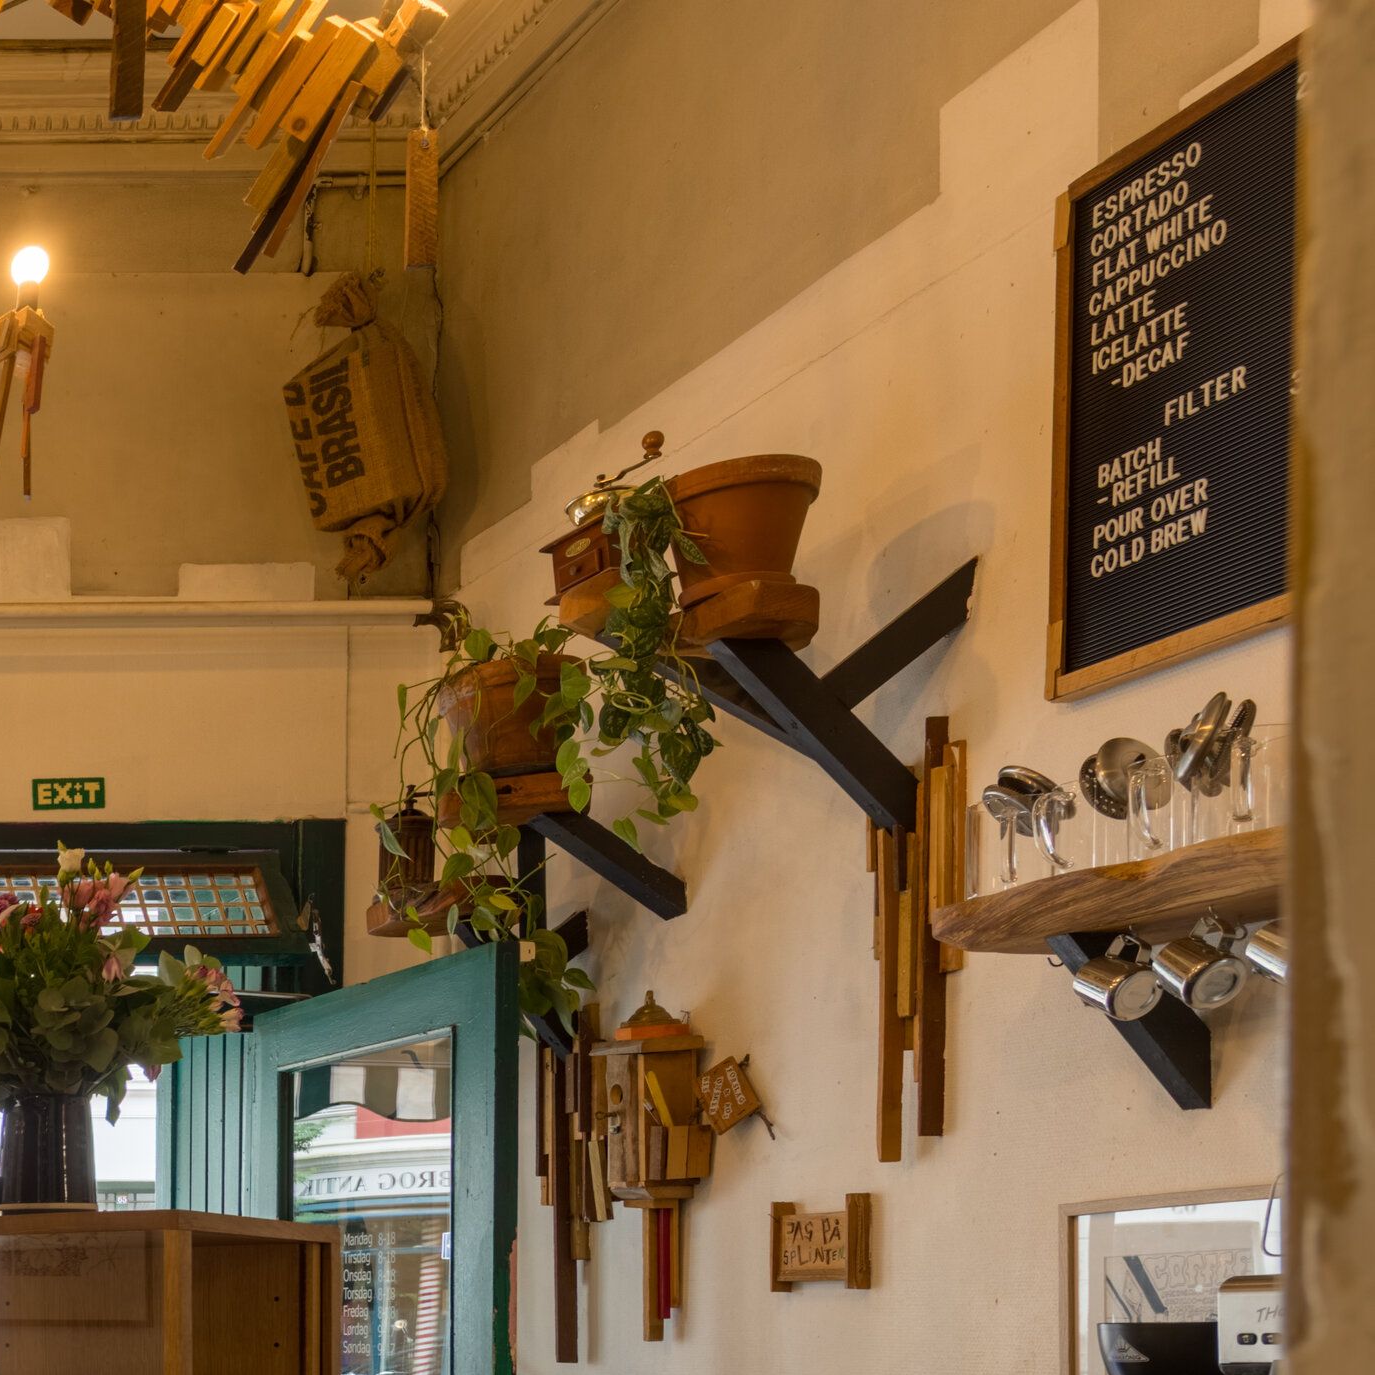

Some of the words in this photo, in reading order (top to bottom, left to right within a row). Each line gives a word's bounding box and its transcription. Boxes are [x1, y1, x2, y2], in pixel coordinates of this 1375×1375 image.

[1092, 142, 1201, 229] ESPRESSO
[1091, 181, 1189, 257] CORTADO
[1092, 238, 1140, 287] FLAT
[1146, 194, 1214, 254] WHITE
[1089, 219, 1227, 316] CAPPUCCINO
[1091, 290, 1156, 346] LATTE
[1092, 302, 1188, 375] ICELATTE
[309, 357, 365, 487] BRASIL
[1164, 366, 1247, 426] FILTER
[1097, 437, 1162, 488] BATCH
[1093, 506, 1144, 549] POUR
[1151, 478, 1209, 522] OVER
[1091, 536, 1146, 578] COLD
[1151, 507, 1209, 554] BREW
[37, 782, 100, 805] EXIT
[344, 1233, 372, 1247] Mandag
[378, 1232, 395, 1245] 8-18
[822, 1218, 841, 1244] PÅ
[343, 1269, 371, 1284] Onsdag
[344, 1252, 370, 1266] Tirsdag
[378, 1251, 395, 1263] 8-18
[343, 1287, 372, 1302] Torsdag
[343, 1305, 368, 1320] Fredag
[343, 1323, 368, 1338] Lørdag
[343, 1341, 370, 1357] Søndag
